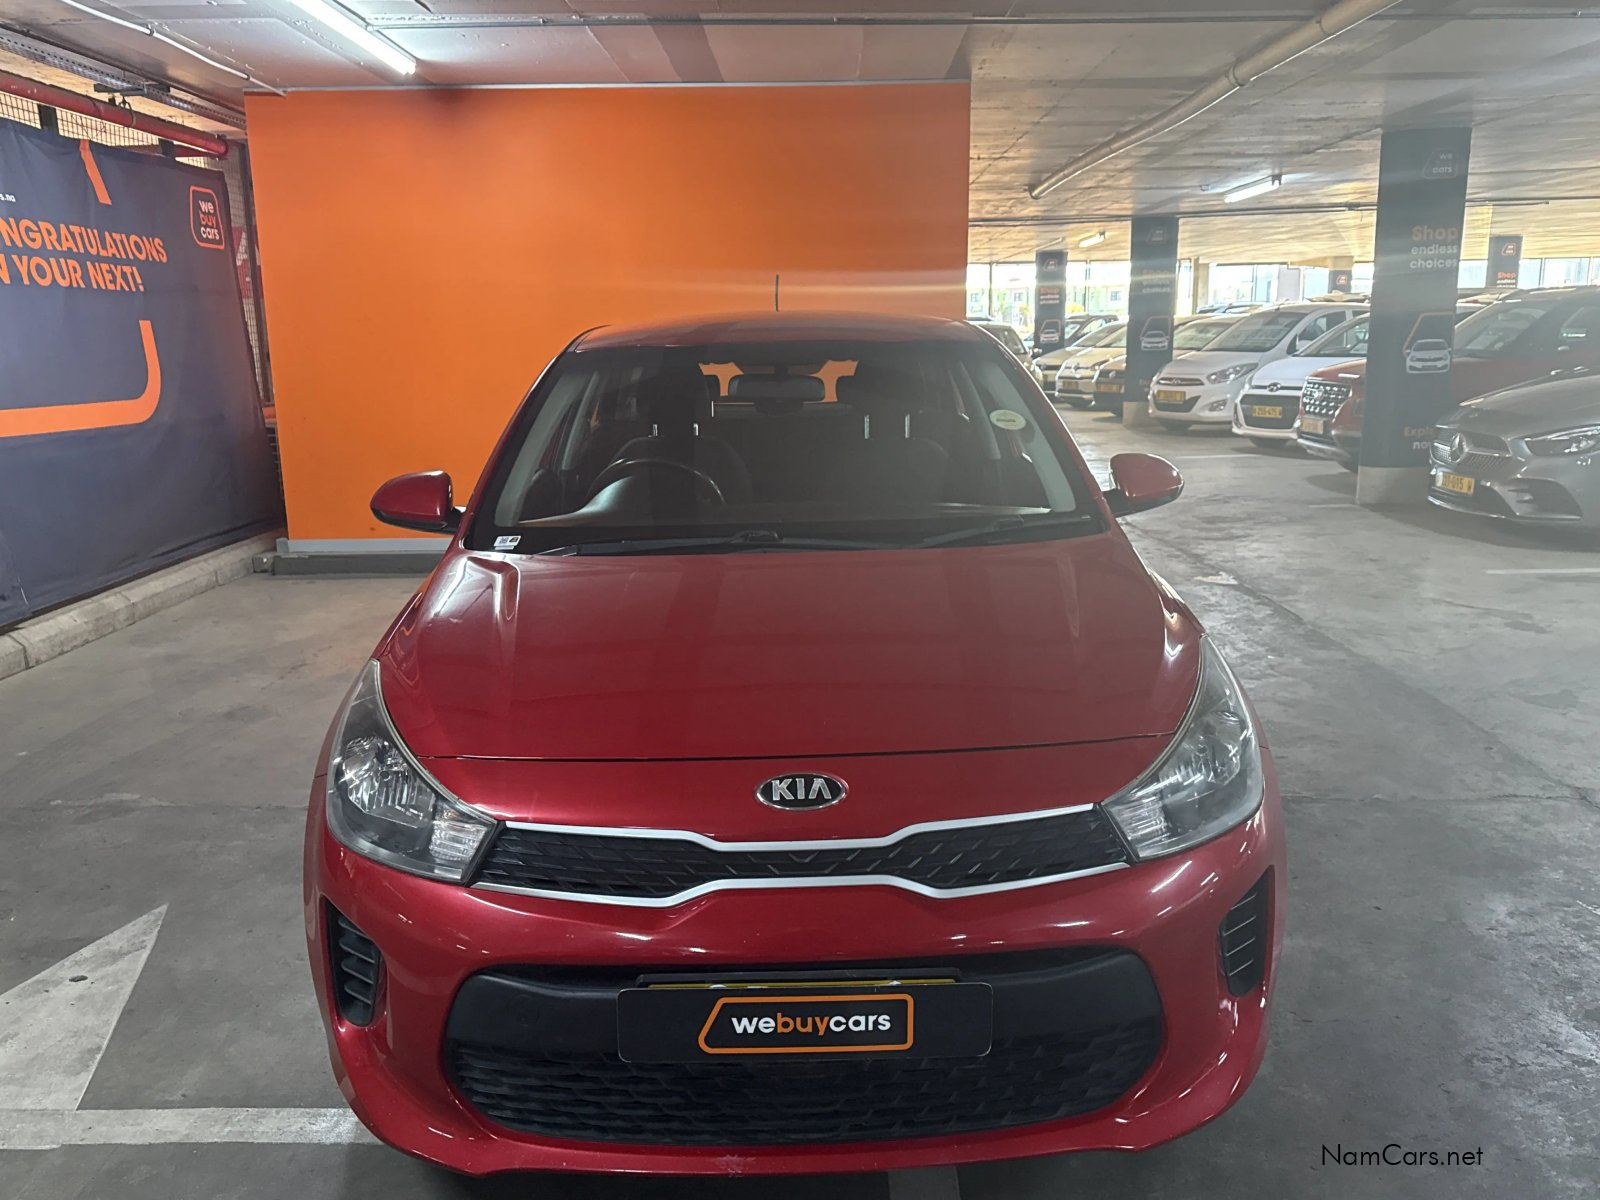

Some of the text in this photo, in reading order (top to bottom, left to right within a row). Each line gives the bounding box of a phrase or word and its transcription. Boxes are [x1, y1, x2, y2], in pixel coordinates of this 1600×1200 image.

[199, 200, 214, 213] we
[199, 210, 217, 228] buy
[201, 227, 219, 240] cars
[1412, 225, 1459, 244] Shop
[1411, 244, 1458, 255] endless
[1409, 258, 1458, 269] choices
[11, 254, 86, 288] YOUR
[86, 260, 145, 292] NEXT!
[771, 777, 832, 801] KIA
[731, 1011, 892, 1037] webuycars
